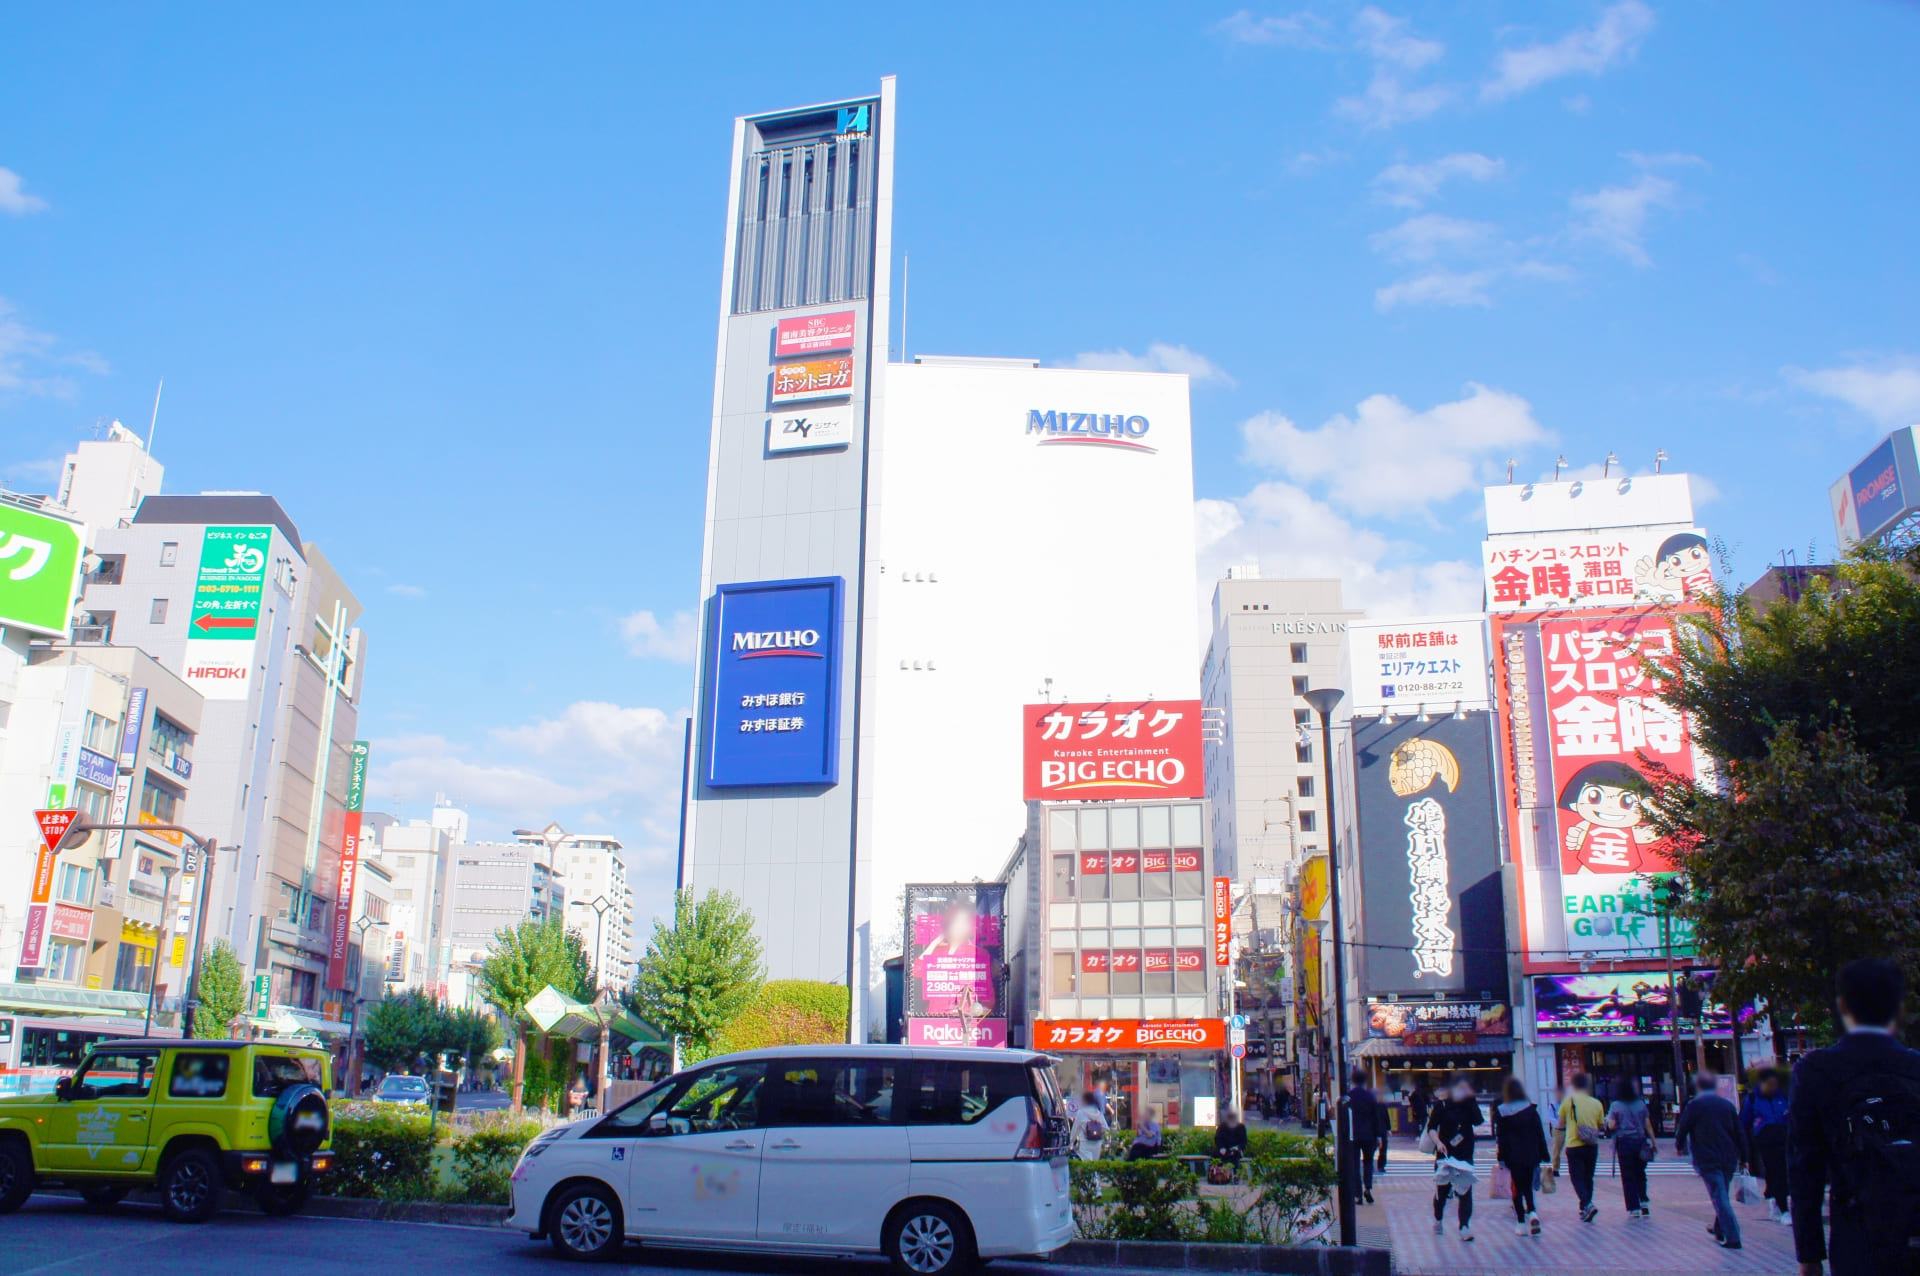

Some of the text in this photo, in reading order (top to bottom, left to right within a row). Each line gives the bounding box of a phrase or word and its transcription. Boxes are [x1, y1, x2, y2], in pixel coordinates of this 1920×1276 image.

[777, 369, 851, 392] ホットヨガ
[782, 418, 813, 438] ZXY
[1028, 408, 1151, 436] MIZUHO
[1856, 464, 1896, 509] PROMISE
[207, 532, 232, 540] ビジネス
[1583, 560, 1622, 578] 蒲田
[1492, 563, 1571, 603] 金時
[1576, 578, 1634, 597] 東口店
[195, 600, 258, 609] この角、左折すぐ
[732, 629, 821, 651] MIZUHO
[1378, 631, 1459, 649] 駅前店舗は
[1547, 629, 1674, 662] パチンコ
[187, 667, 247, 679] HIROKI
[1380, 659, 1461, 677] エリアクエスト
[1397, 682, 1463, 692] 0120-88-27-22
[129, 691, 143, 725] YAMAHA
[741, 692, 805, 708] みずほ銀行
[740, 717, 804, 732] みずほ証券
[1041, 709, 1184, 741] カラオケ
[1552, 695, 1684, 757] 金時
[80, 750, 105, 768] STAR
[1053, 747, 1169, 758] Karaoke Entertainment
[1515, 706, 1537, 803] PACHINKO
[91, 764, 113, 786] Lesson
[176, 757, 190, 774] TBC
[351, 757, 365, 790] ビジネス
[1041, 757, 1185, 788] BIG ECHO
[41, 814, 69, 825] 止まれ
[45, 826, 65, 835] STOP
[345, 834, 355, 856] SLOT
[1588, 827, 1631, 867] 金
[1086, 856, 1137, 869] カラオケ
[1143, 857, 1165, 868] BIG
[338, 860, 354, 910] HIROKI
[1216, 882, 1225, 918] BIG ECHO
[334, 914, 346, 959] PACHINKO
[1217, 923, 1228, 962] カラオケ
[1087, 955, 1138, 967] カラオケ
[1145, 956, 1167, 967] BIG
[1050, 1027, 1124, 1044] カラオケ
[1136, 1028, 1207, 1043] BIG ECHO
